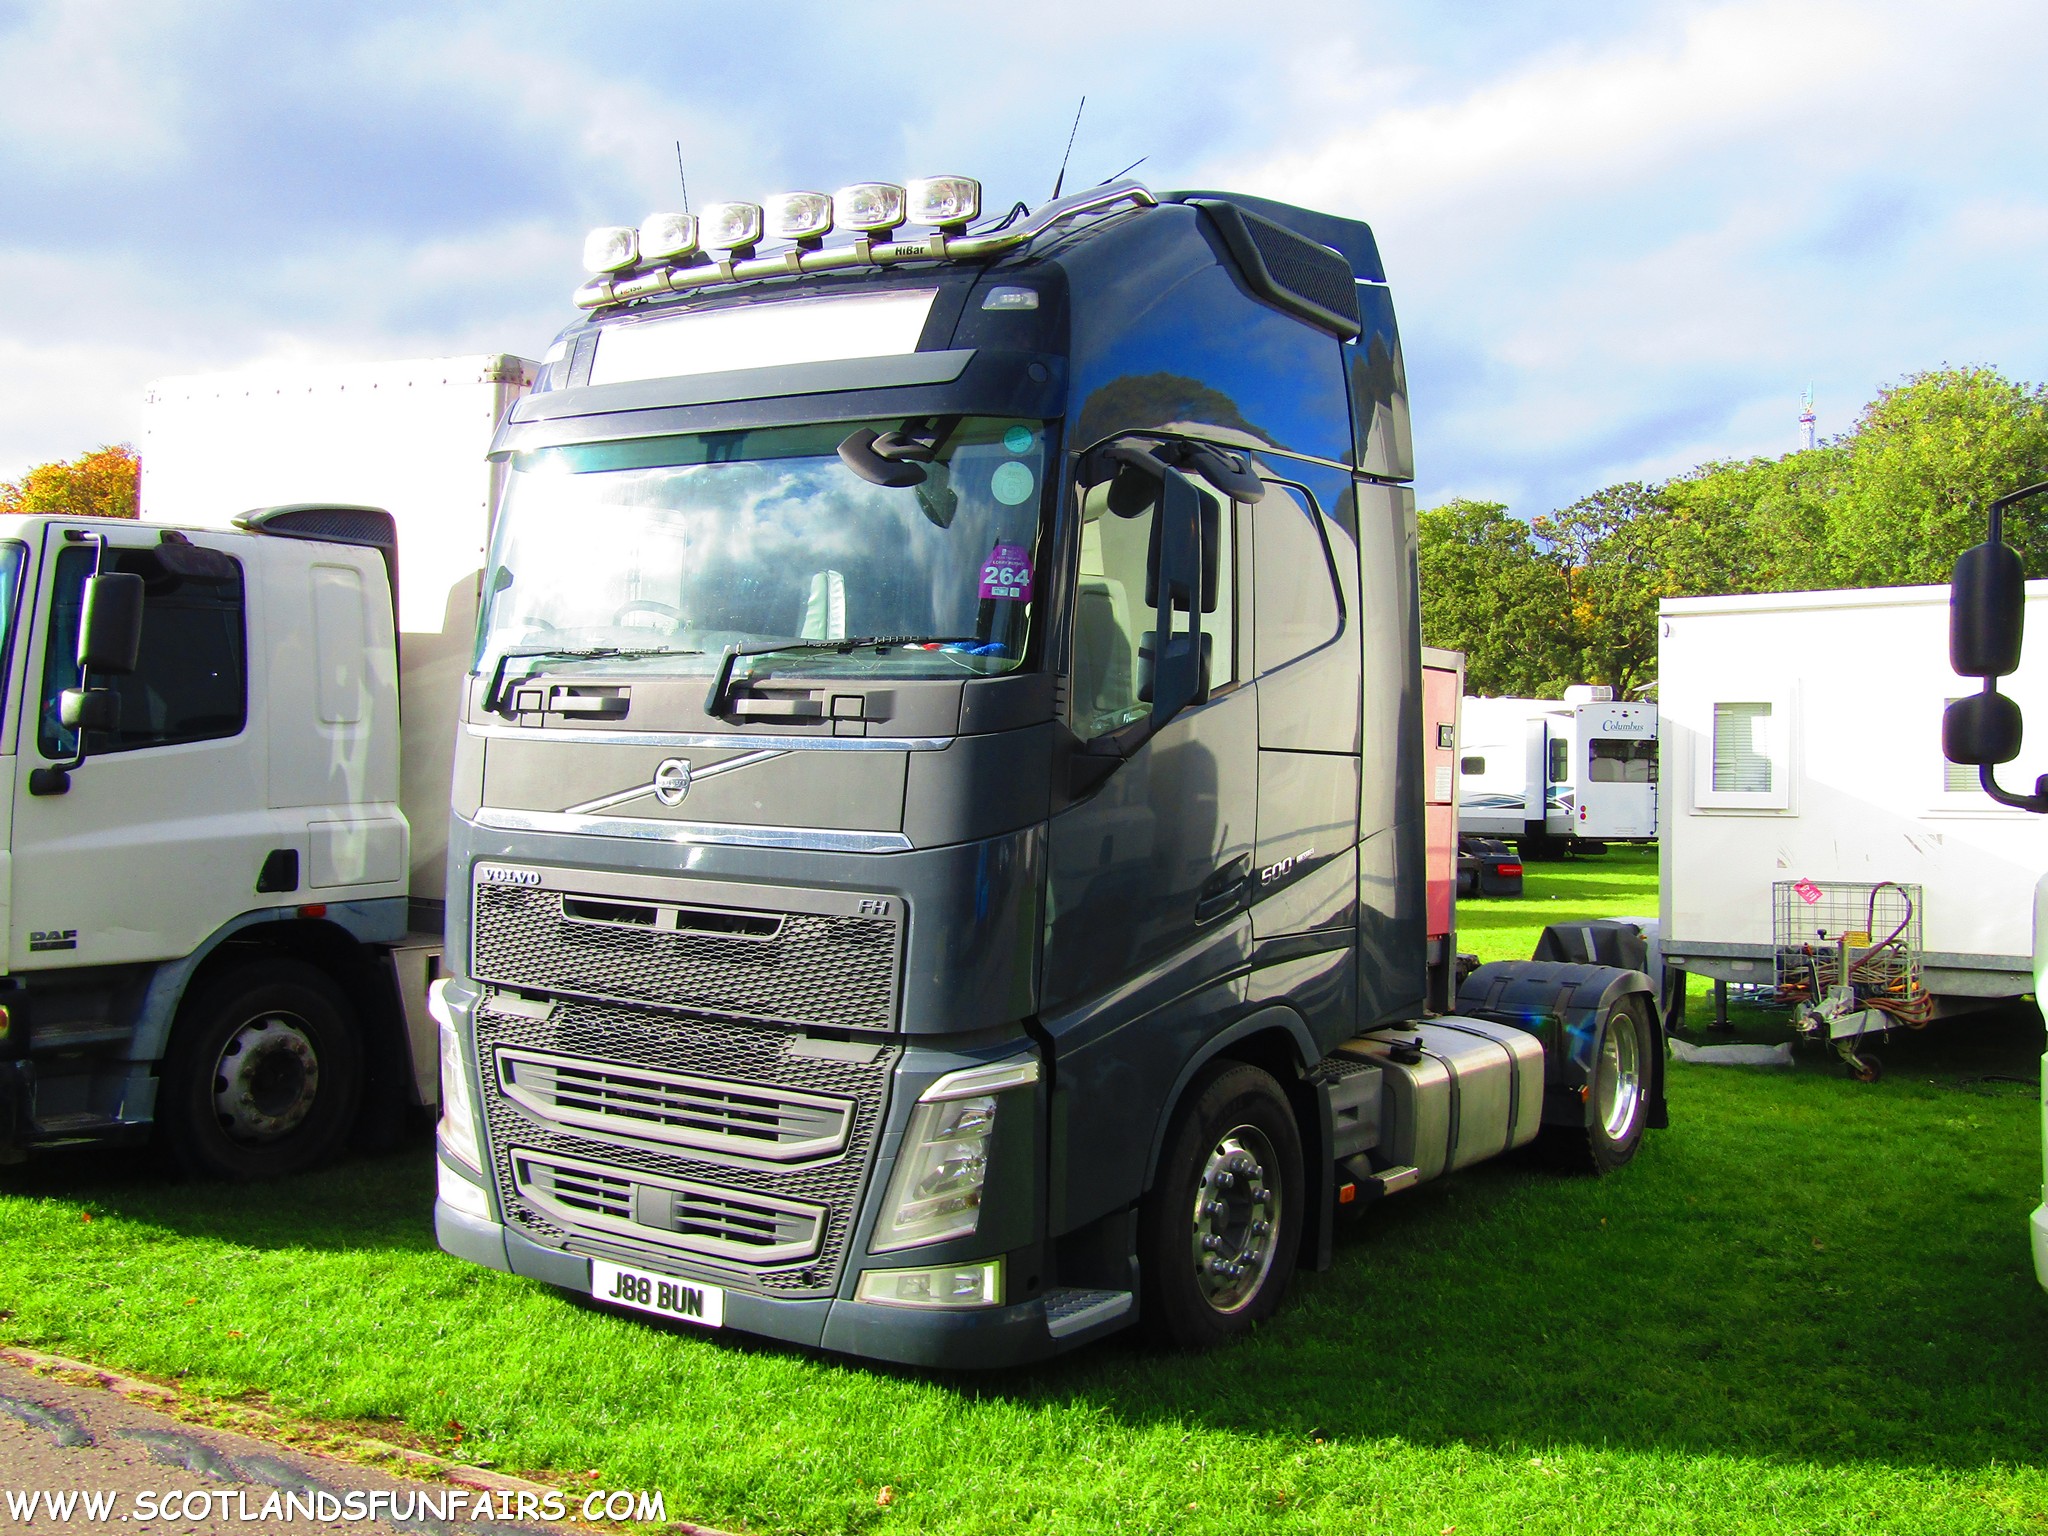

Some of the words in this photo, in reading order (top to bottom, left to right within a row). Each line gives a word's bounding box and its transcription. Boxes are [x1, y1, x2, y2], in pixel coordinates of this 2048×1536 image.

[895, 245, 924, 256] HiBar
[983, 566, 1030, 587] 264
[1602, 719, 1644, 731] Columbus
[480, 866, 541, 886] VOLVO
[1261, 856, 1293, 886] 500
[858, 899, 890, 916] FH
[30, 929, 78, 941] DAF
[608, 1271, 652, 1305] J88
[657, 1281, 704, 1318] BUN
